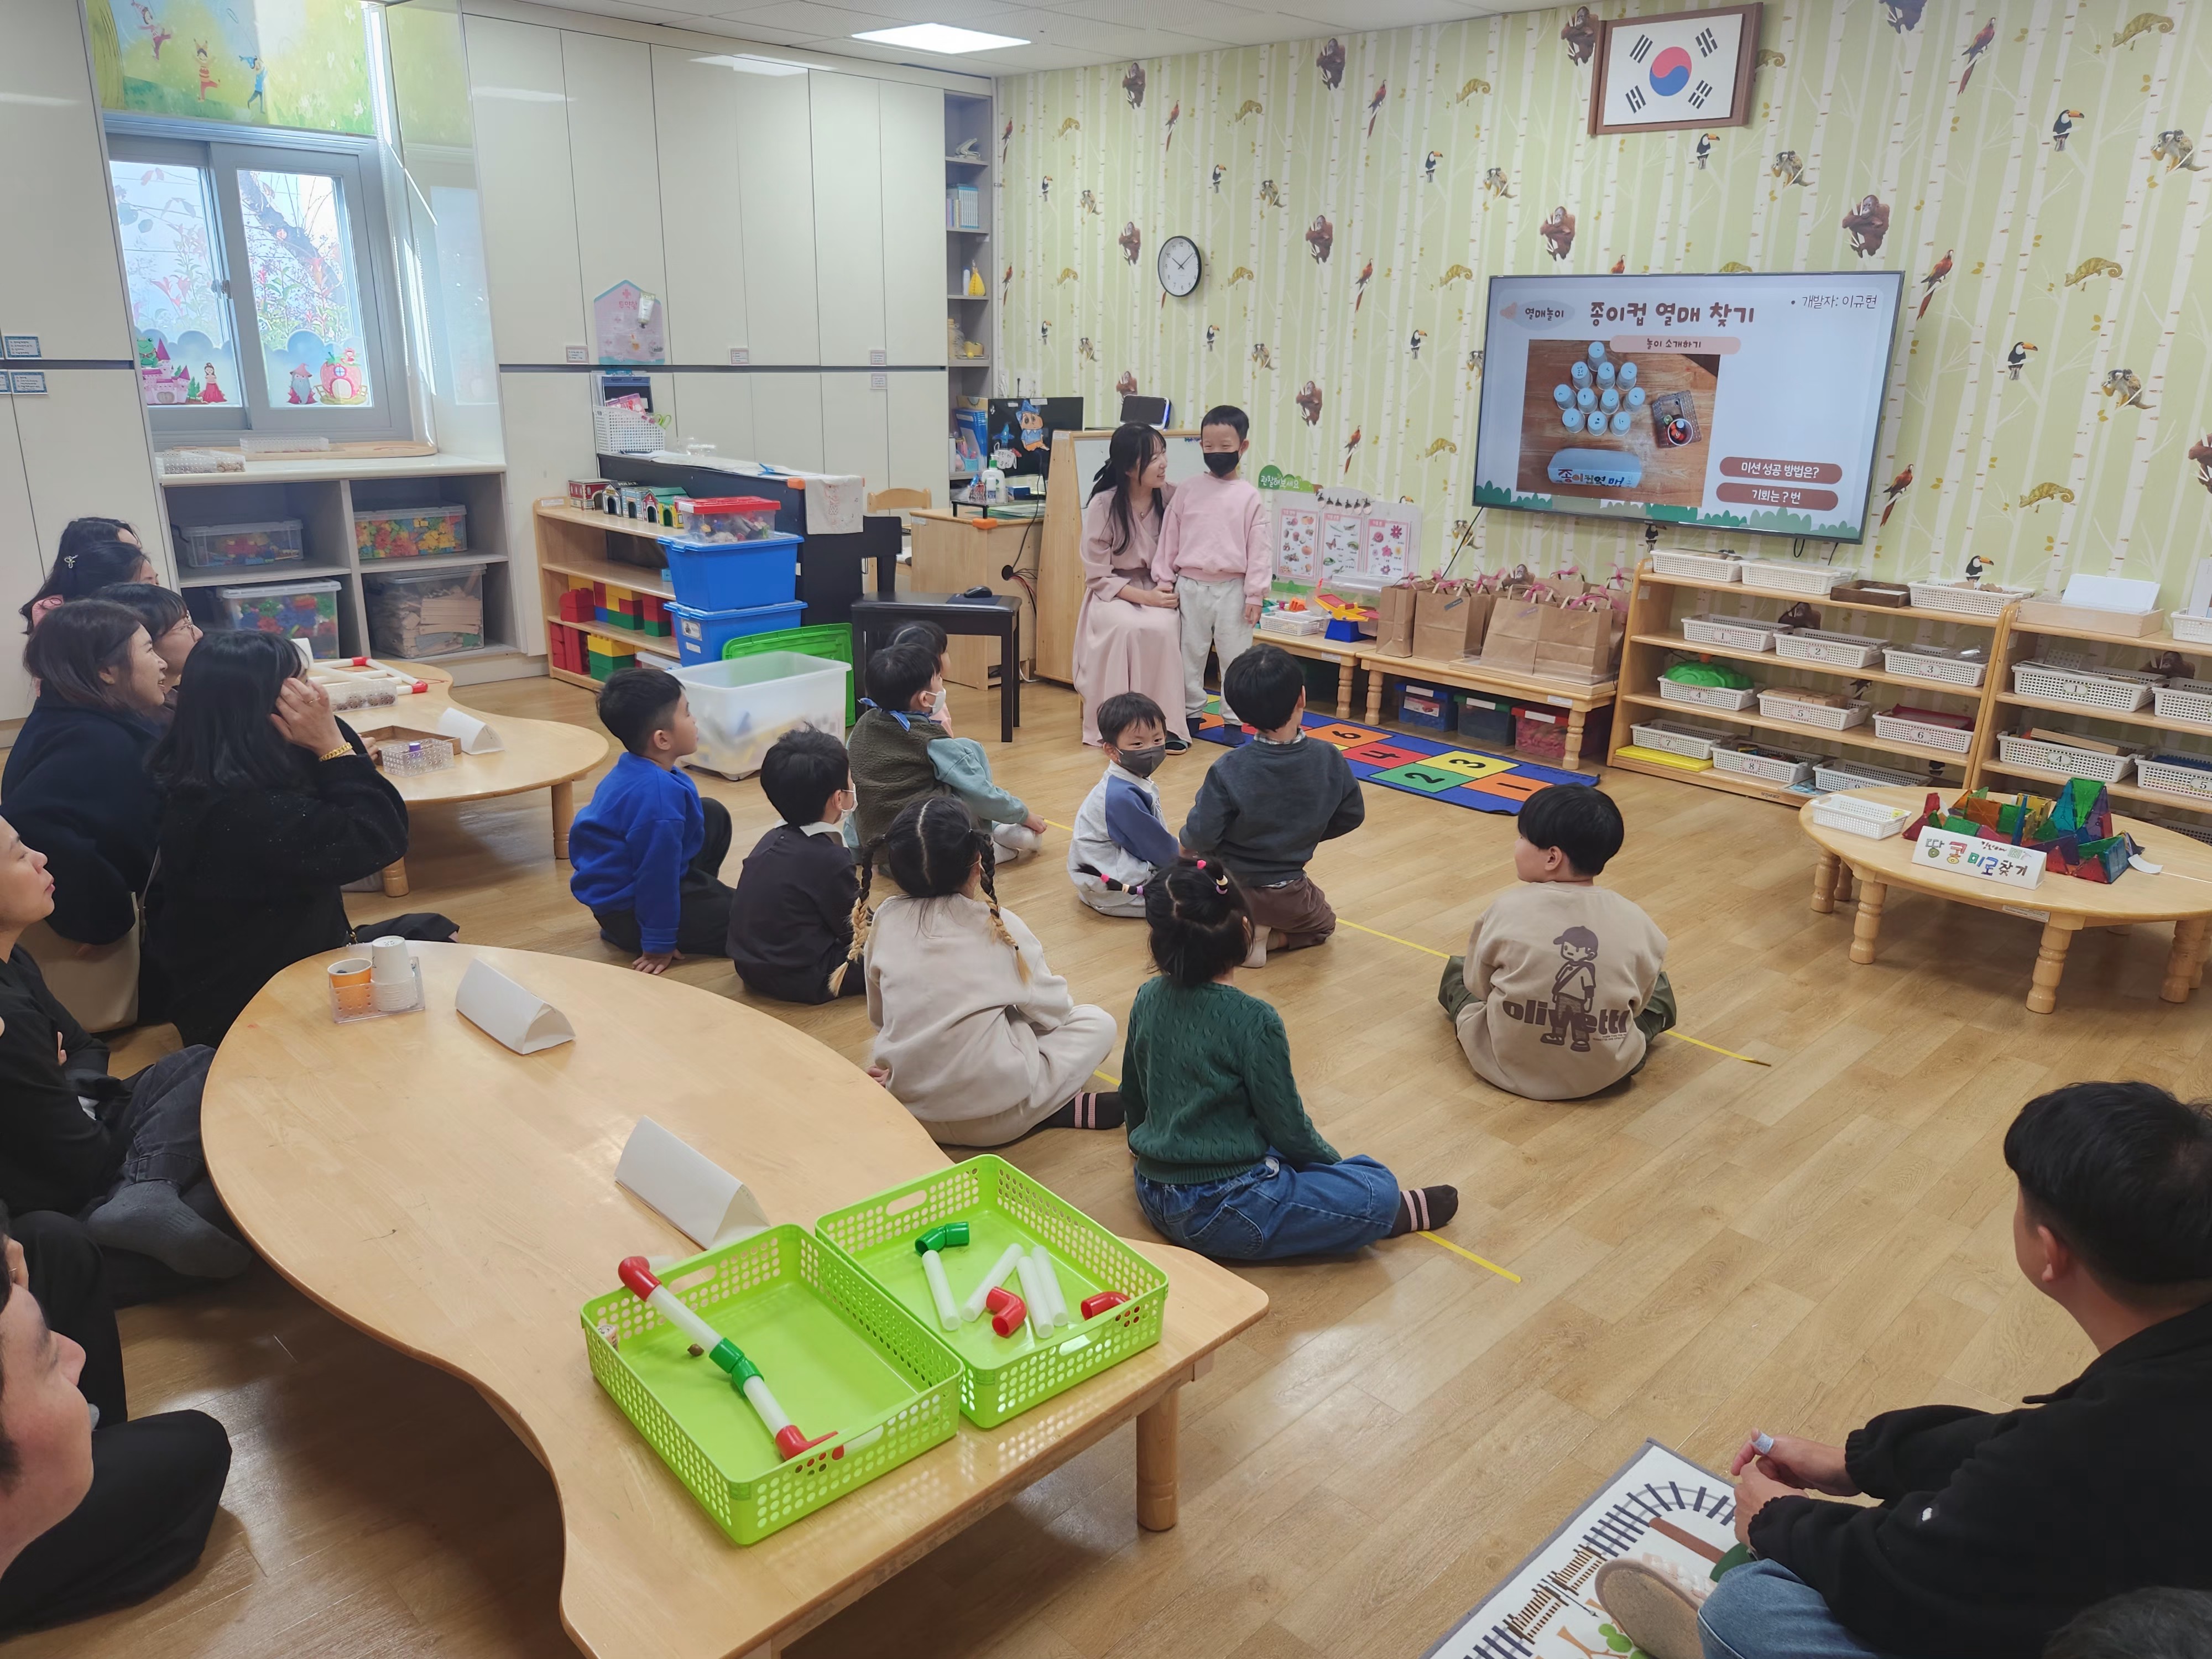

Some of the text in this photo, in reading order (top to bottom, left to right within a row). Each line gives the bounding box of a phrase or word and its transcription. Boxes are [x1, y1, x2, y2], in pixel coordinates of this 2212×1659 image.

[1802, 295, 1877, 309] 개발자: 이규현
[1525, 307, 1564, 321] 열매놀이
[1590, 302, 1755, 327] 종이컵 열매 찾기
[1647, 338, 1702, 350] 놀이 소개하기
[1741, 462, 1820, 478] 미션 성공 방법은?
[1260, 474, 1300, 489] 관찰해보세요
[1751, 489, 1801, 504] 기회는 ? 번
[1815, 648, 1821, 656] 2
[1927, 665, 1933, 674] 3
[2073, 685, 2078, 693] 1
[1332, 730, 1361, 739] 6
[1359, 749, 1402, 759] 4
[1448, 758, 1487, 769] 3
[1404, 772, 1446, 784] 2
[1496, 782, 1533, 792] 1
[2199, 781, 2207, 790] 5
